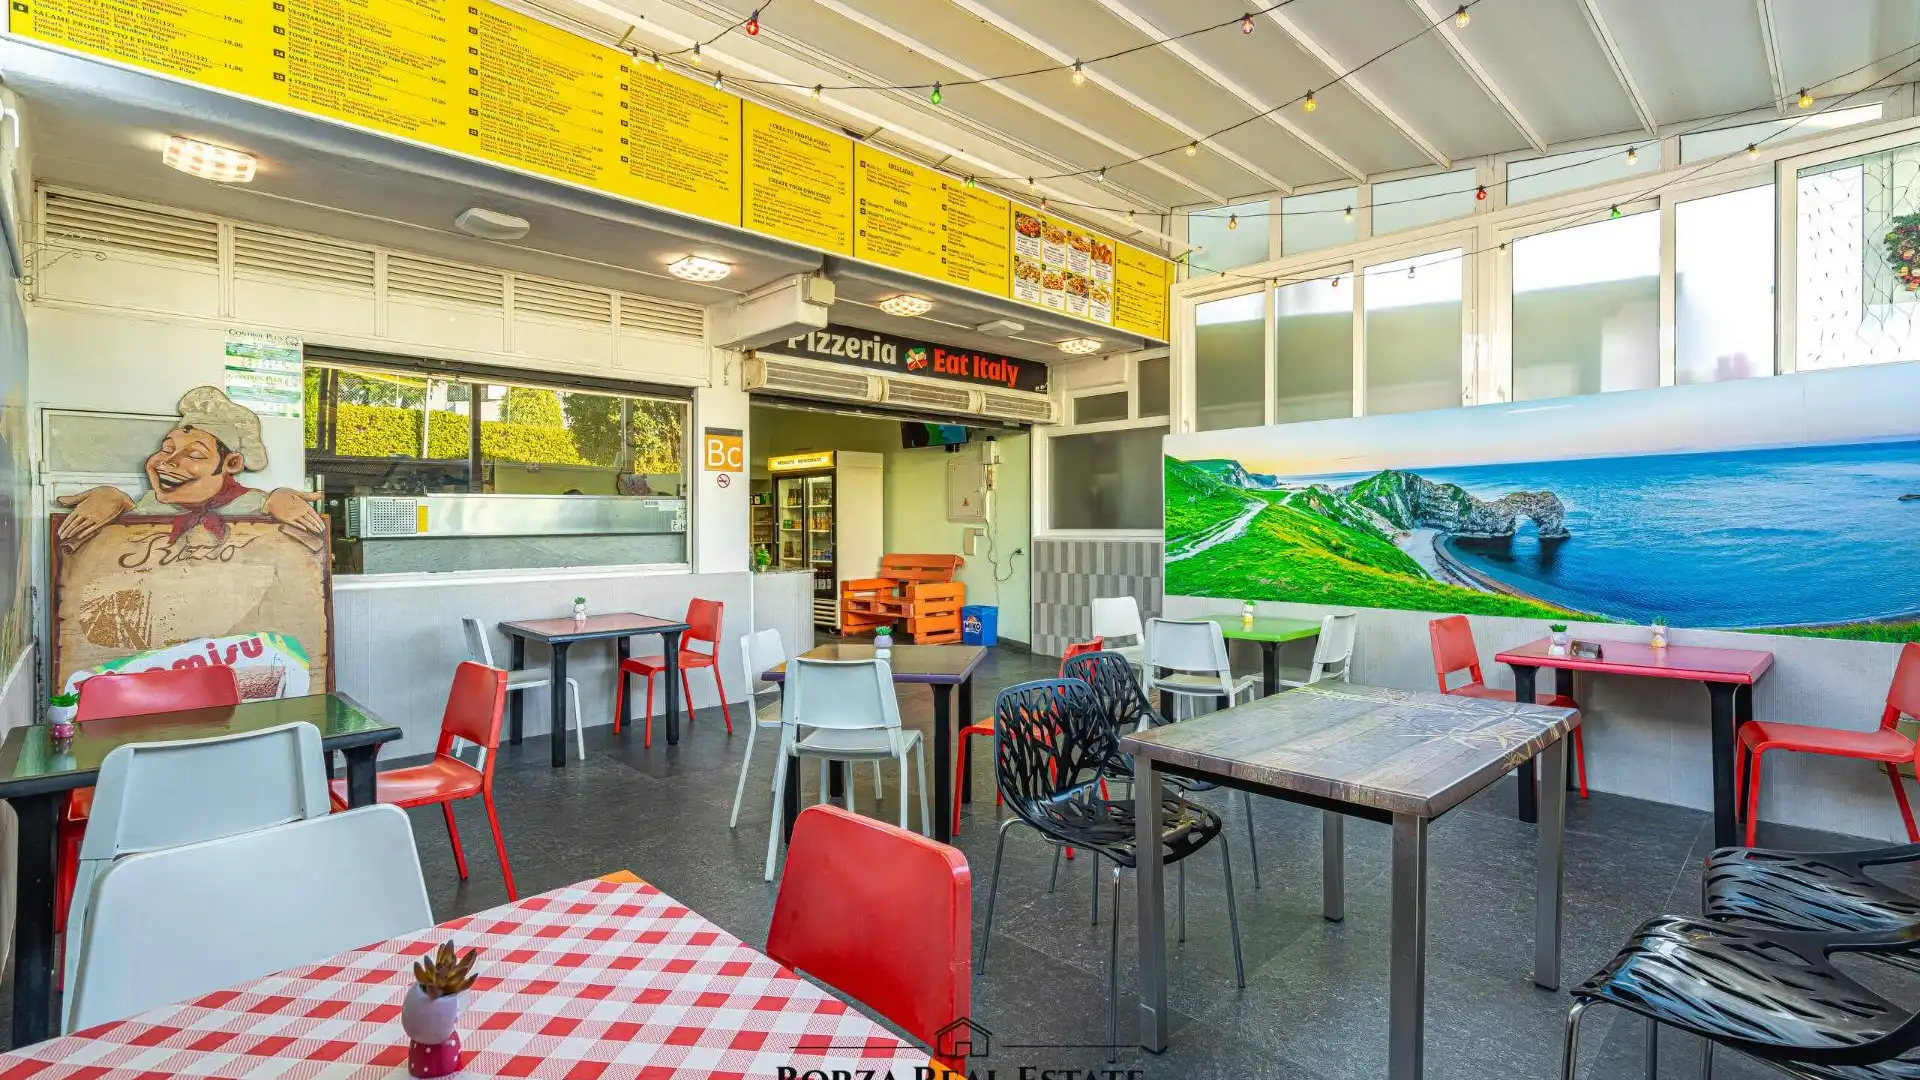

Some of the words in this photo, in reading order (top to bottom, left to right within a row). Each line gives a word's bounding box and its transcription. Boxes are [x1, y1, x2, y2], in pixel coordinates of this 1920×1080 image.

[101, 3, 133, 16] FUNGHI
[288, 8, 334, 27] VEGETARIANA
[34, 9, 68, 22] SALAME
[72, 20, 128, 40] PROSCIUTTO
[138, 37, 169, 52] FUNGHI
[288, 31, 312, 42] TONNO
[934, 348, 968, 376] Eat
[972, 356, 1020, 388] Italy
[706, 438, 742, 468] Bc
